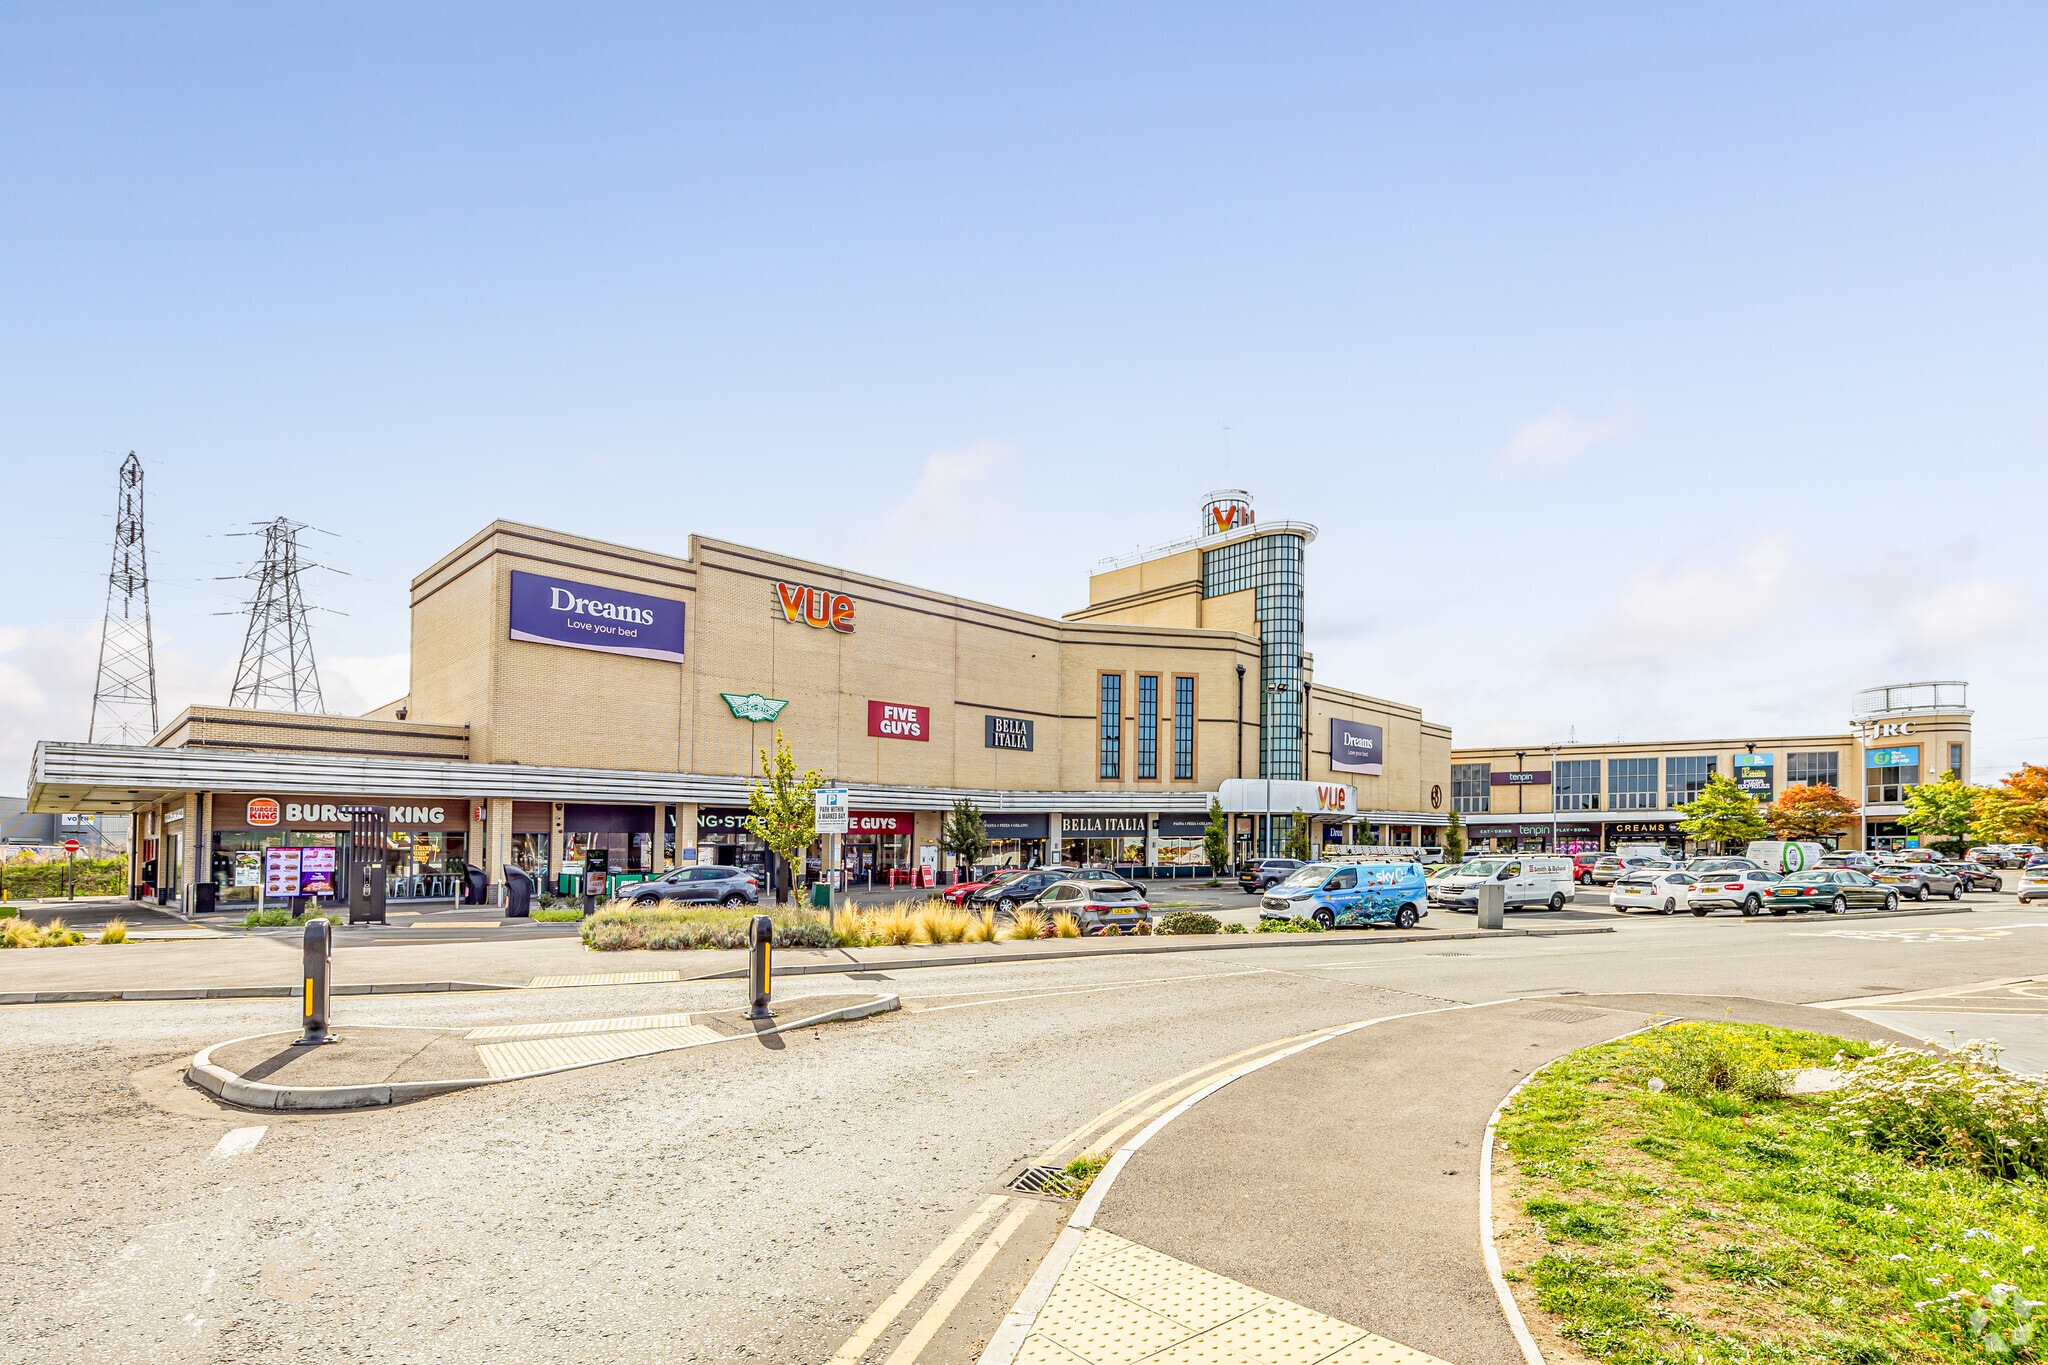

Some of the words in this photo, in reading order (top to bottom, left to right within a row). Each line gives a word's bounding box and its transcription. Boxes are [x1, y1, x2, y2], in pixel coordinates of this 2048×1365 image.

[550, 586, 654, 626] Dreams
[567, 618, 592, 631] Love
[594, 624, 616, 634] your
[618, 626, 638, 638] bed
[884, 705, 917, 722] FIVE
[880, 719, 921, 737] GUYS
[995, 718, 1027, 735] BELLA
[1869, 721, 1917, 740] JRC
[994, 732, 1028, 749] ITALIA
[1343, 731, 1373, 749] Dreams
[1509, 773, 1533, 783] tenpin
[249, 812, 278, 820] KING
[389, 805, 445, 824] KING
[860, 817, 897, 830] GUYS
[1062, 818, 1102, 831] BELLA
[1105, 818, 1146, 831] ITALIA
[1519, 825, 1550, 837] tenpin
[1616, 823, 1665, 832] CREAMS
[1330, 828, 1343, 837] Drea
[1375, 869, 1395, 886] sky
